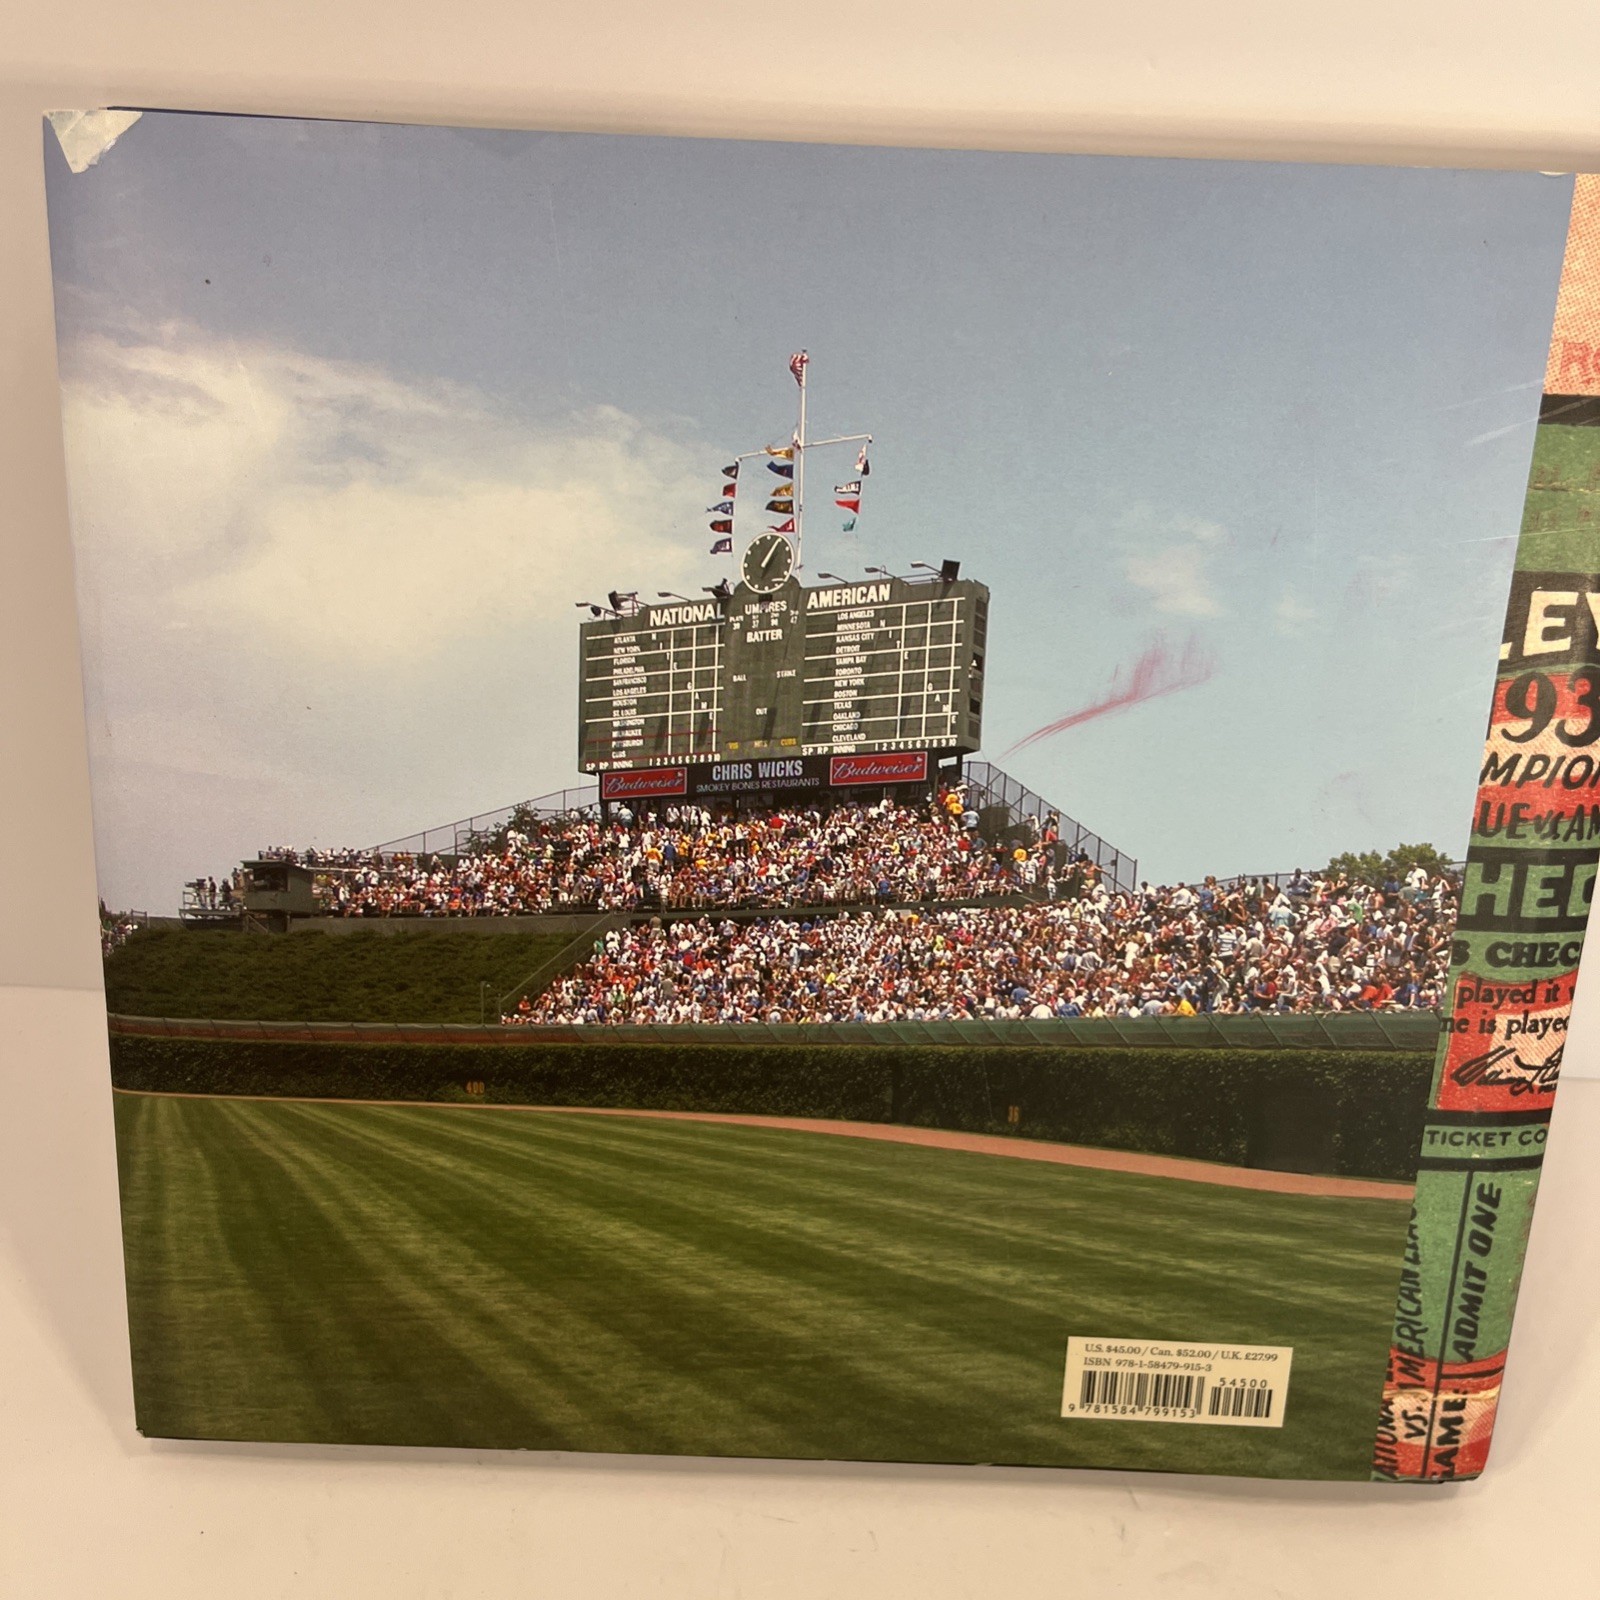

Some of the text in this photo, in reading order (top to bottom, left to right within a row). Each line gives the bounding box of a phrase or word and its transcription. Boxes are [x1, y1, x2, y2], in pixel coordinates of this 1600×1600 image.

[806, 584, 891, 609] AMERICAN
[650, 603, 724, 626] NATIONAL
[836, 622, 870, 632] MINNESOTA
[746, 628, 782, 643] BATTER
[836, 632, 874, 642] KANSAS CITY
[732, 674, 746, 682] BALL
[834, 678, 864, 688] NEW YORK
[834, 690, 858, 698] BOSTON
[756, 708, 768, 716] OUT
[834, 701, 852, 710] TEXAS
[832, 712, 860, 720] OAKLAND
[832, 723, 858, 732] CHICAGO
[832, 733, 866, 742] CLEVELAND
[802, 748, 813, 756] SP
[817, 746, 828, 754] RP
[713, 760, 802, 781] CHRIS WICKS
[833, 760, 923, 780] Budweiser
[606, 776, 683, 794] Budweiser
[696, 777, 820, 793] SMOKEY BONES RESTAURANTS
[1485, 940, 1580, 967] CHEC
[1457, 979, 1537, 1010] played
[1544, 979, 1560, 1003] it
[1478, 1010, 1496, 1034] is
[1426, 1130, 1511, 1147] TICKET
[1453, 1182, 1501, 1363] ADMIT ONE
[1085, 1344, 1104, 1353] U.S.
[1106, 1344, 1142, 1354] $45.00
[1150, 1346, 1174, 1356] Can.
[1176, 1348, 1212, 1358] $52.00
[1220, 1350, 1242, 1360] U.K.
[1244, 1352, 1278, 1362] £27.99
[1084, 1357, 1212, 1372] ISBN 978-1-58479-915-3
[1219, 1377, 1268, 1388] 54500
[1068, 1403, 1196, 1418] 9 781584 799153
